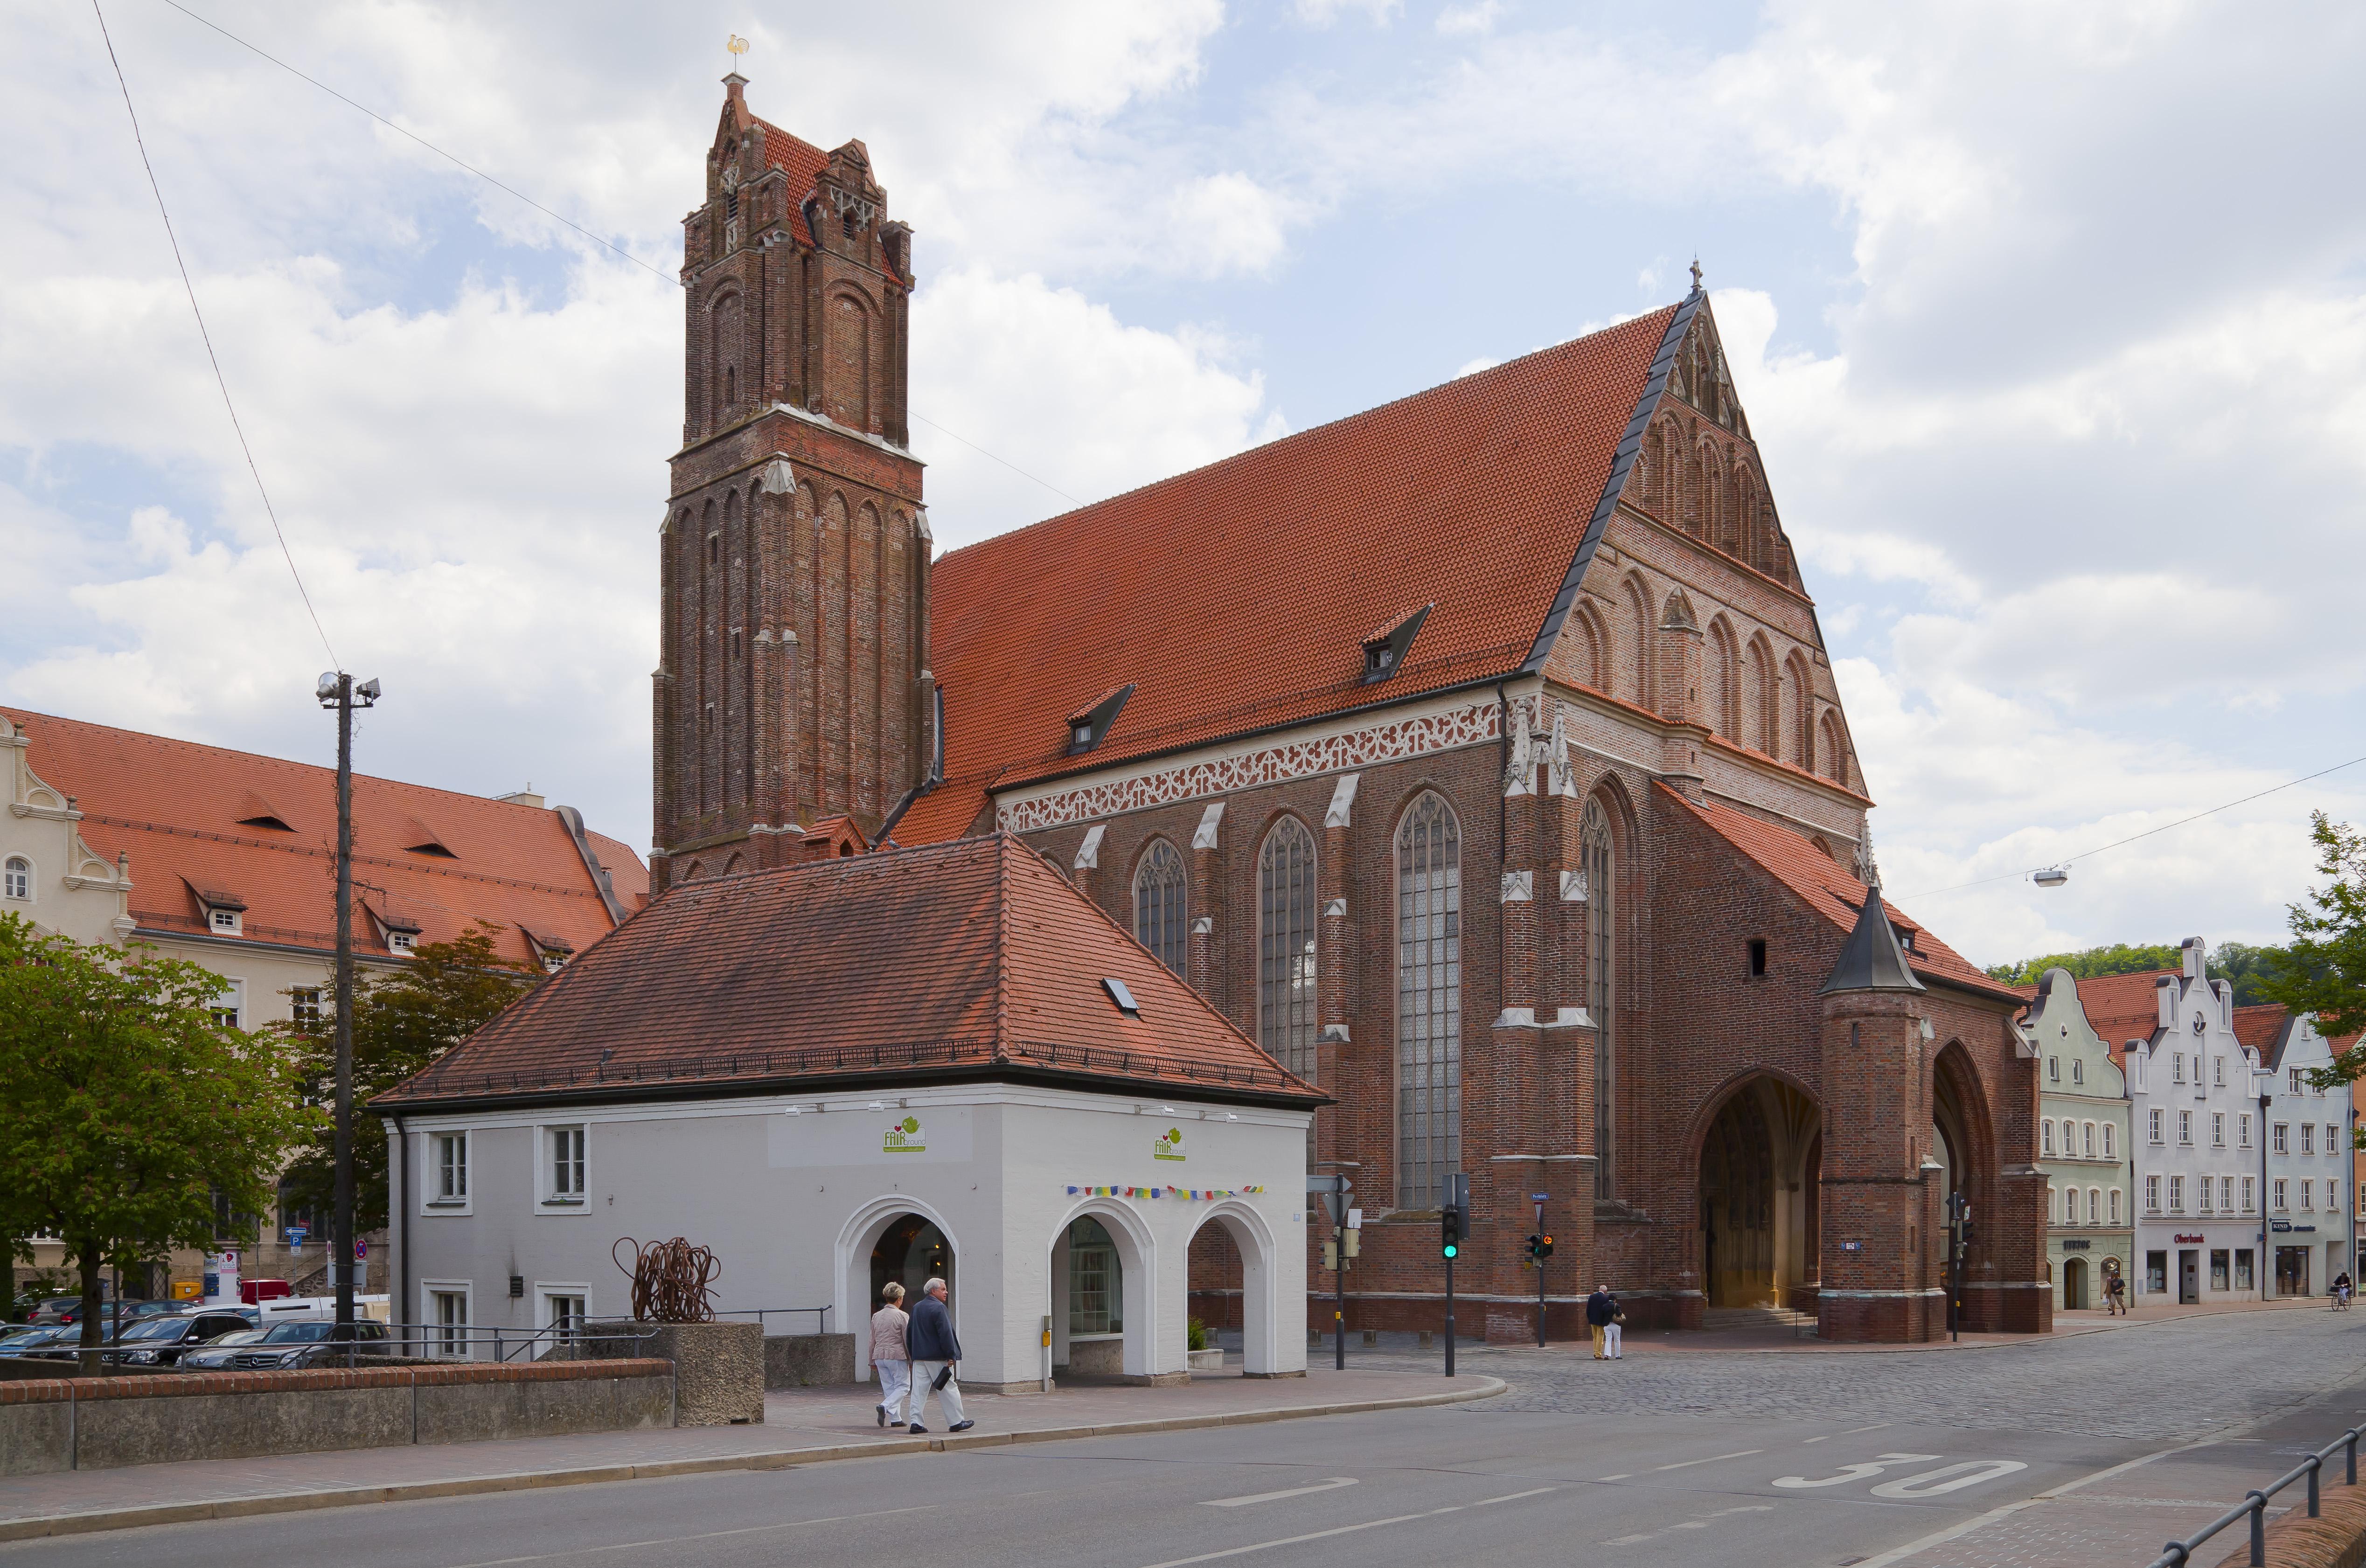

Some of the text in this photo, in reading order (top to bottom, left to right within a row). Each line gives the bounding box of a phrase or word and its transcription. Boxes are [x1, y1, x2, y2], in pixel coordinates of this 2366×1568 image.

[293, 1237, 299, 1245] P
[2174, 1233, 2204, 1243] Oberbank
[1772, 1452, 2028, 1498] 30
